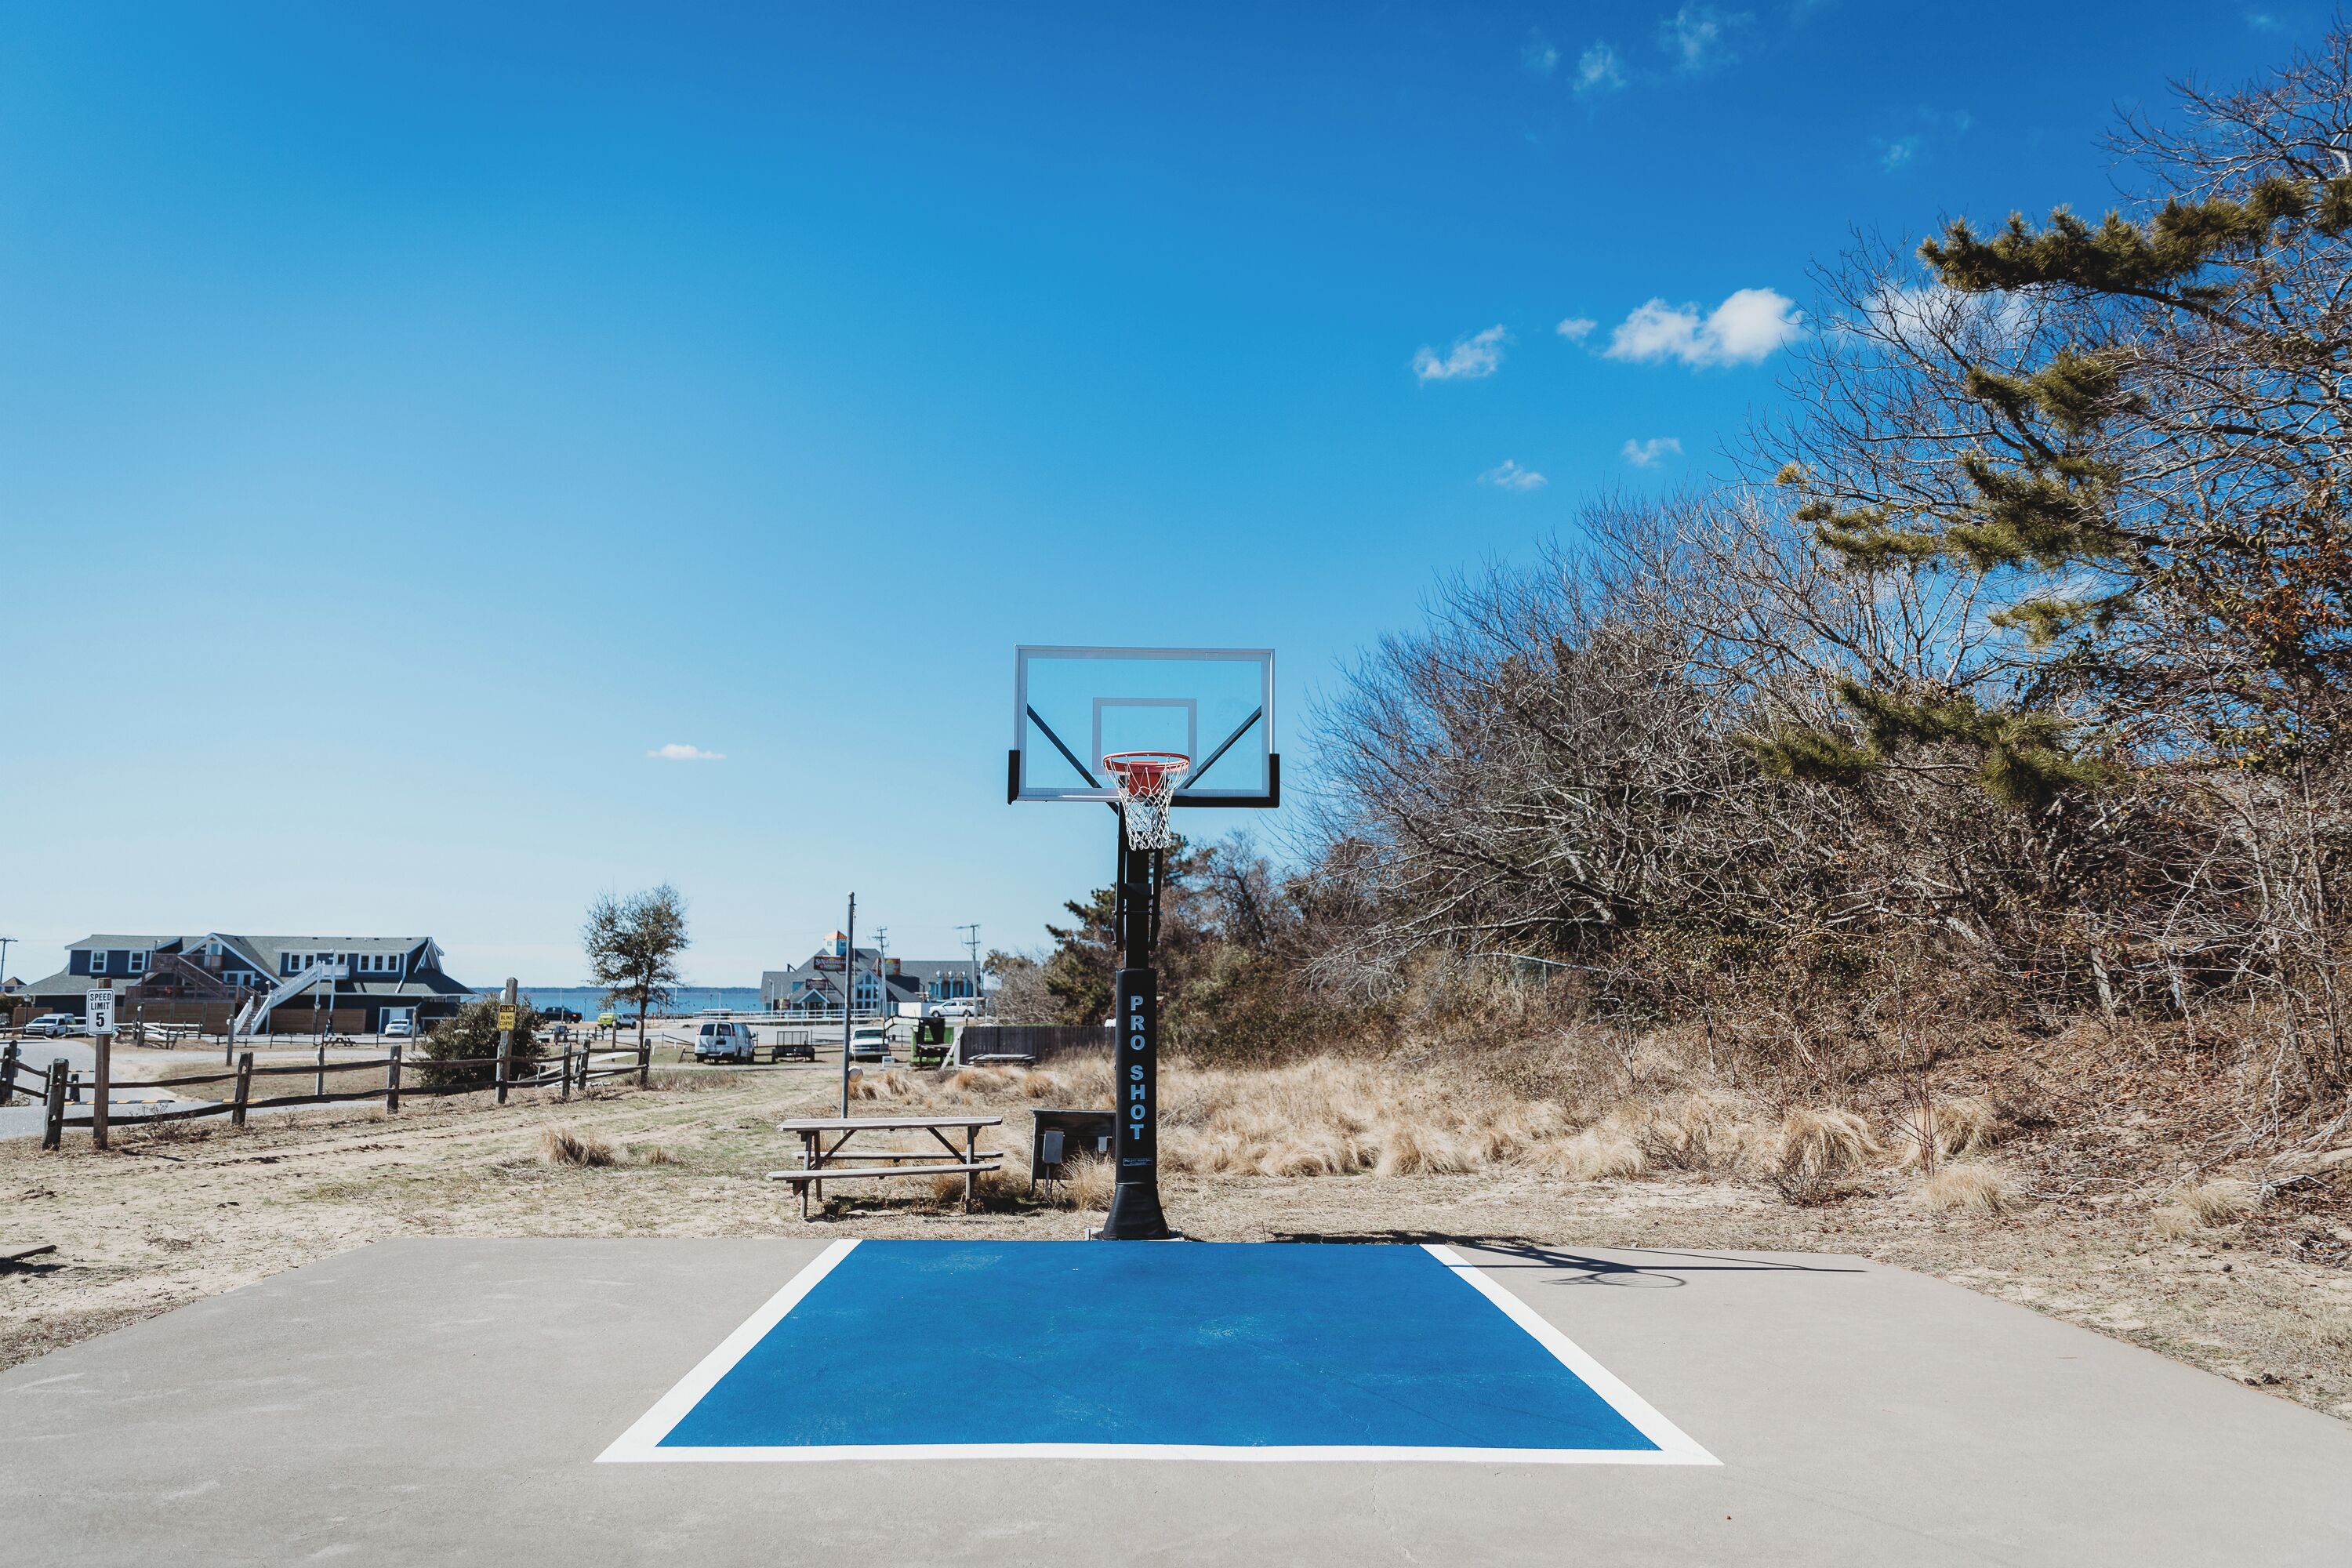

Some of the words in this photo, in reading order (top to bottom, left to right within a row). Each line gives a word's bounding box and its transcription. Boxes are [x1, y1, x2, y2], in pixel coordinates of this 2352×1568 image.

[96, 1012, 104, 1027] 5
[1130, 996, 1145, 1051] PRO
[1130, 1065, 1145, 1140] SHOT
